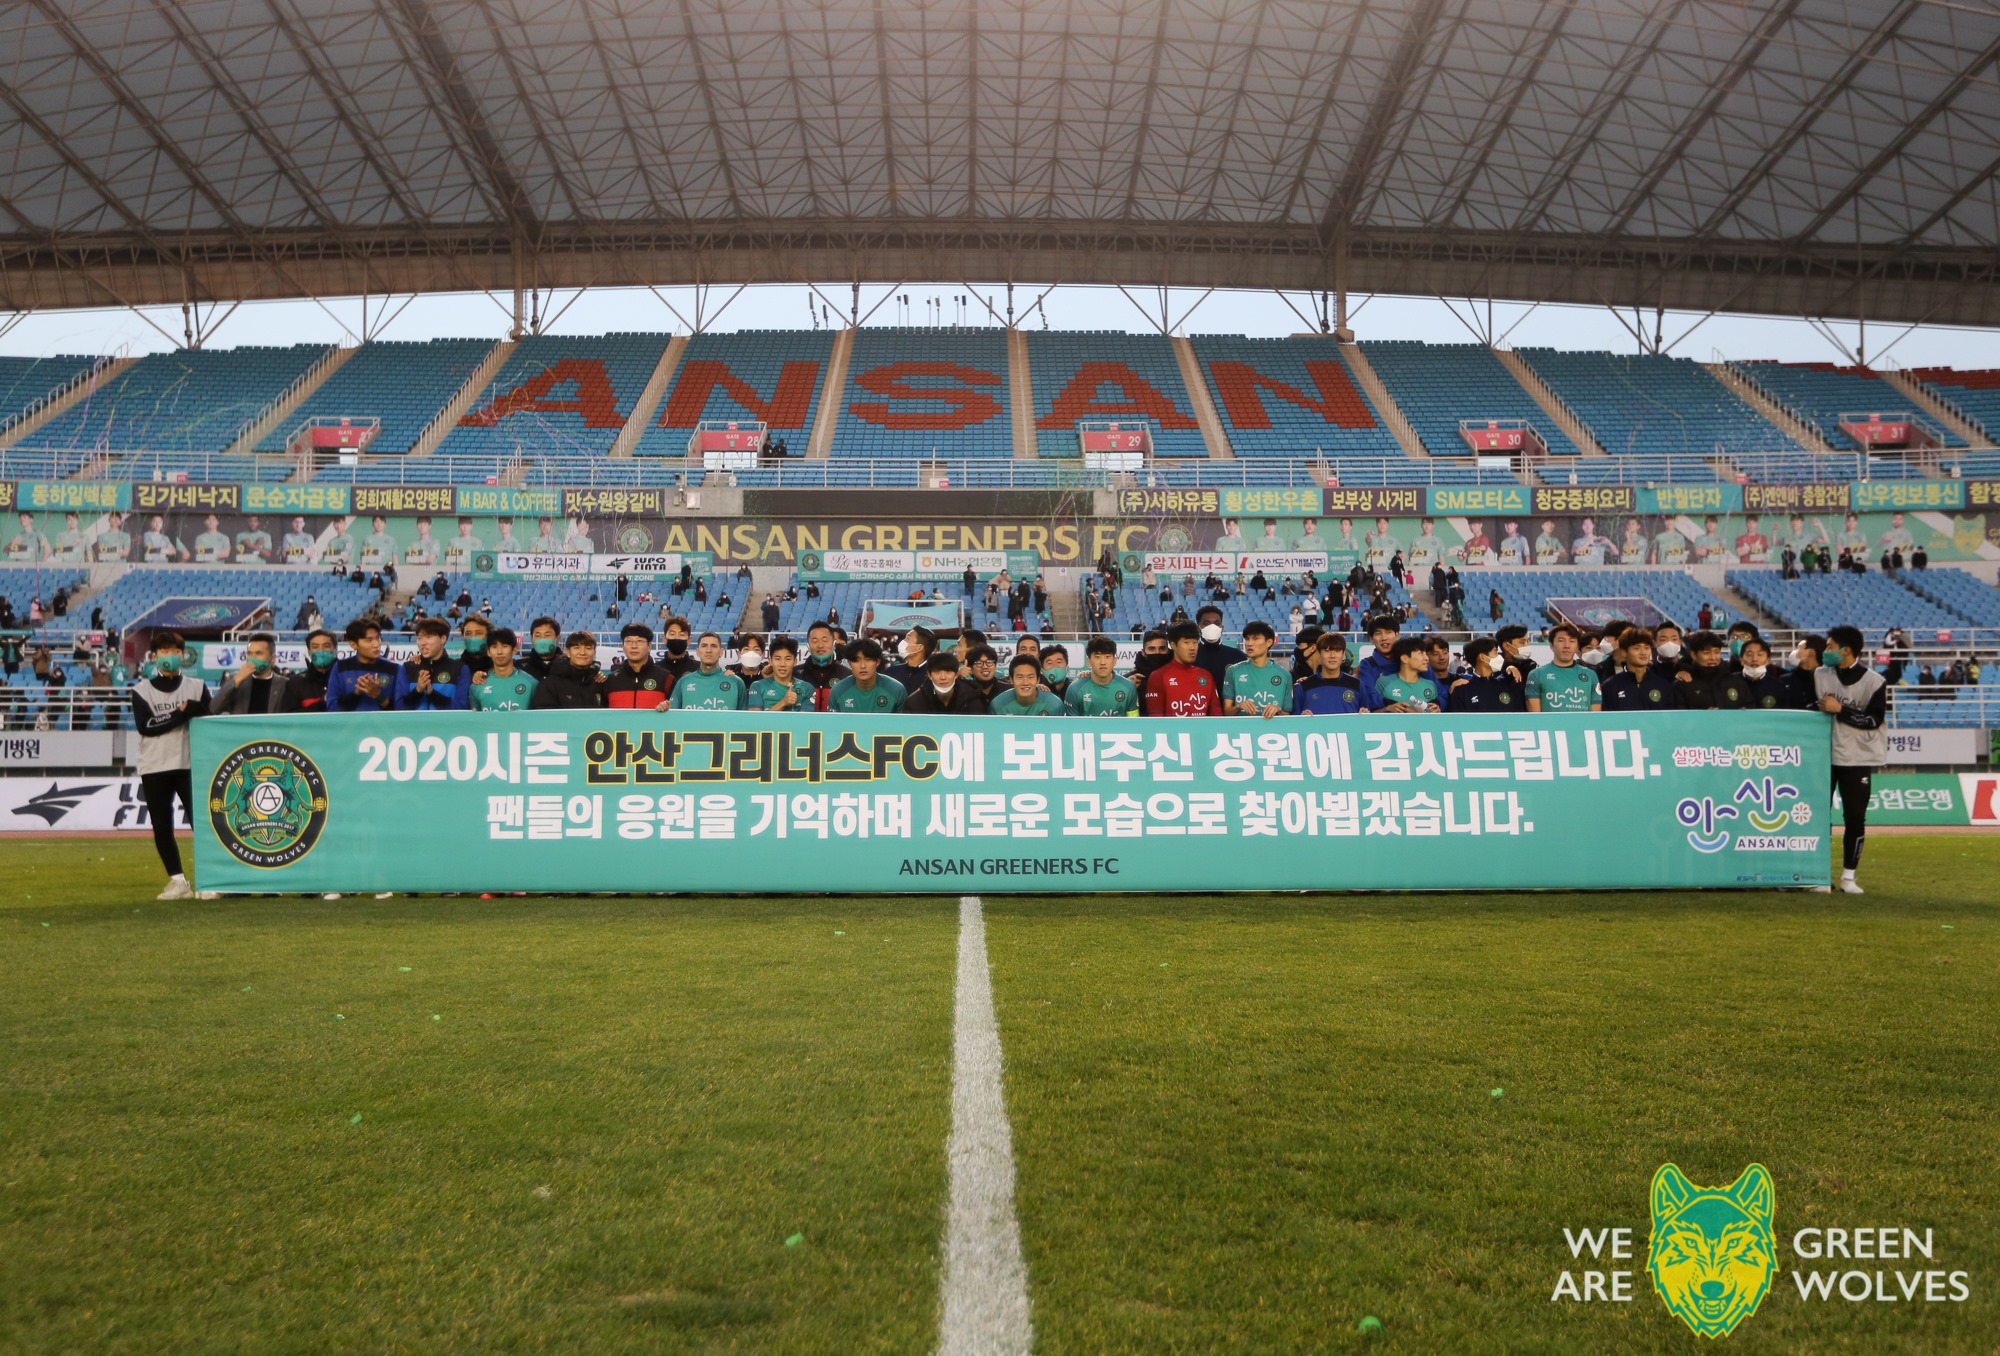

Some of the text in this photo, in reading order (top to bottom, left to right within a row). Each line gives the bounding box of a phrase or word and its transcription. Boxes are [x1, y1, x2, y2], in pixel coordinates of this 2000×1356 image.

[457, 358, 1379, 430] ANSAN
[726, 433, 759, 448] GATE 28
[1107, 433, 1142, 448] GATE 29
[1508, 434, 1521, 446] 30
[1890, 427, 1905, 440] 31
[138, 485, 237, 508] 김가네낙지
[247, 486, 346, 509] 문순자곱창
[355, 488, 452, 511] 경희재활요양병원
[459, 489, 471, 509] M
[473, 489, 498, 511] BAR
[511, 490, 558, 512] COFFEE
[1119, 490, 1218, 513] (주)서하유통
[1331, 490, 1418, 512] 보부상 사거리
[1434, 490, 1523, 511] SM모터스
[1536, 488, 1631, 511] 청궁중화요리
[1855, 482, 1960, 507] 신우정보통신
[662, 524, 829, 561] ANSAN
[840, 524, 1081, 561] GREENERS
[1092, 524, 1150, 561] FC
[532, 555, 580, 571] 유디치과
[634, 556, 667, 564] LUPO
[853, 558, 902, 569] 박홍근홈패션
[934, 556, 1003, 569] NH농협은행
[1152, 557, 1229, 571] 알지파낙스
[1256, 557, 1327, 570] 안산도시개발(주)
[634, 574, 655, 582] ZONE
[934, 573, 959, 581] EVENT
[217, 746, 319, 787] ANSAN GREENERS FC
[358, 730, 1662, 785] 2020시즌 안산그리너스FC에 보내주신 성원에 감사드립니다.
[1673, 746, 1801, 770] 살맛나는 생생도시
[487, 790, 1534, 840] 팬들의 응원을 기억하며 새로운 모습으로 찾아뵙겠습니다.
[232, 842, 306, 863] GREEN WOLVES
[1736, 838, 1818, 850] ANSAN CITY
[899, 858, 1119, 876] ANSAN GREENERS FC
